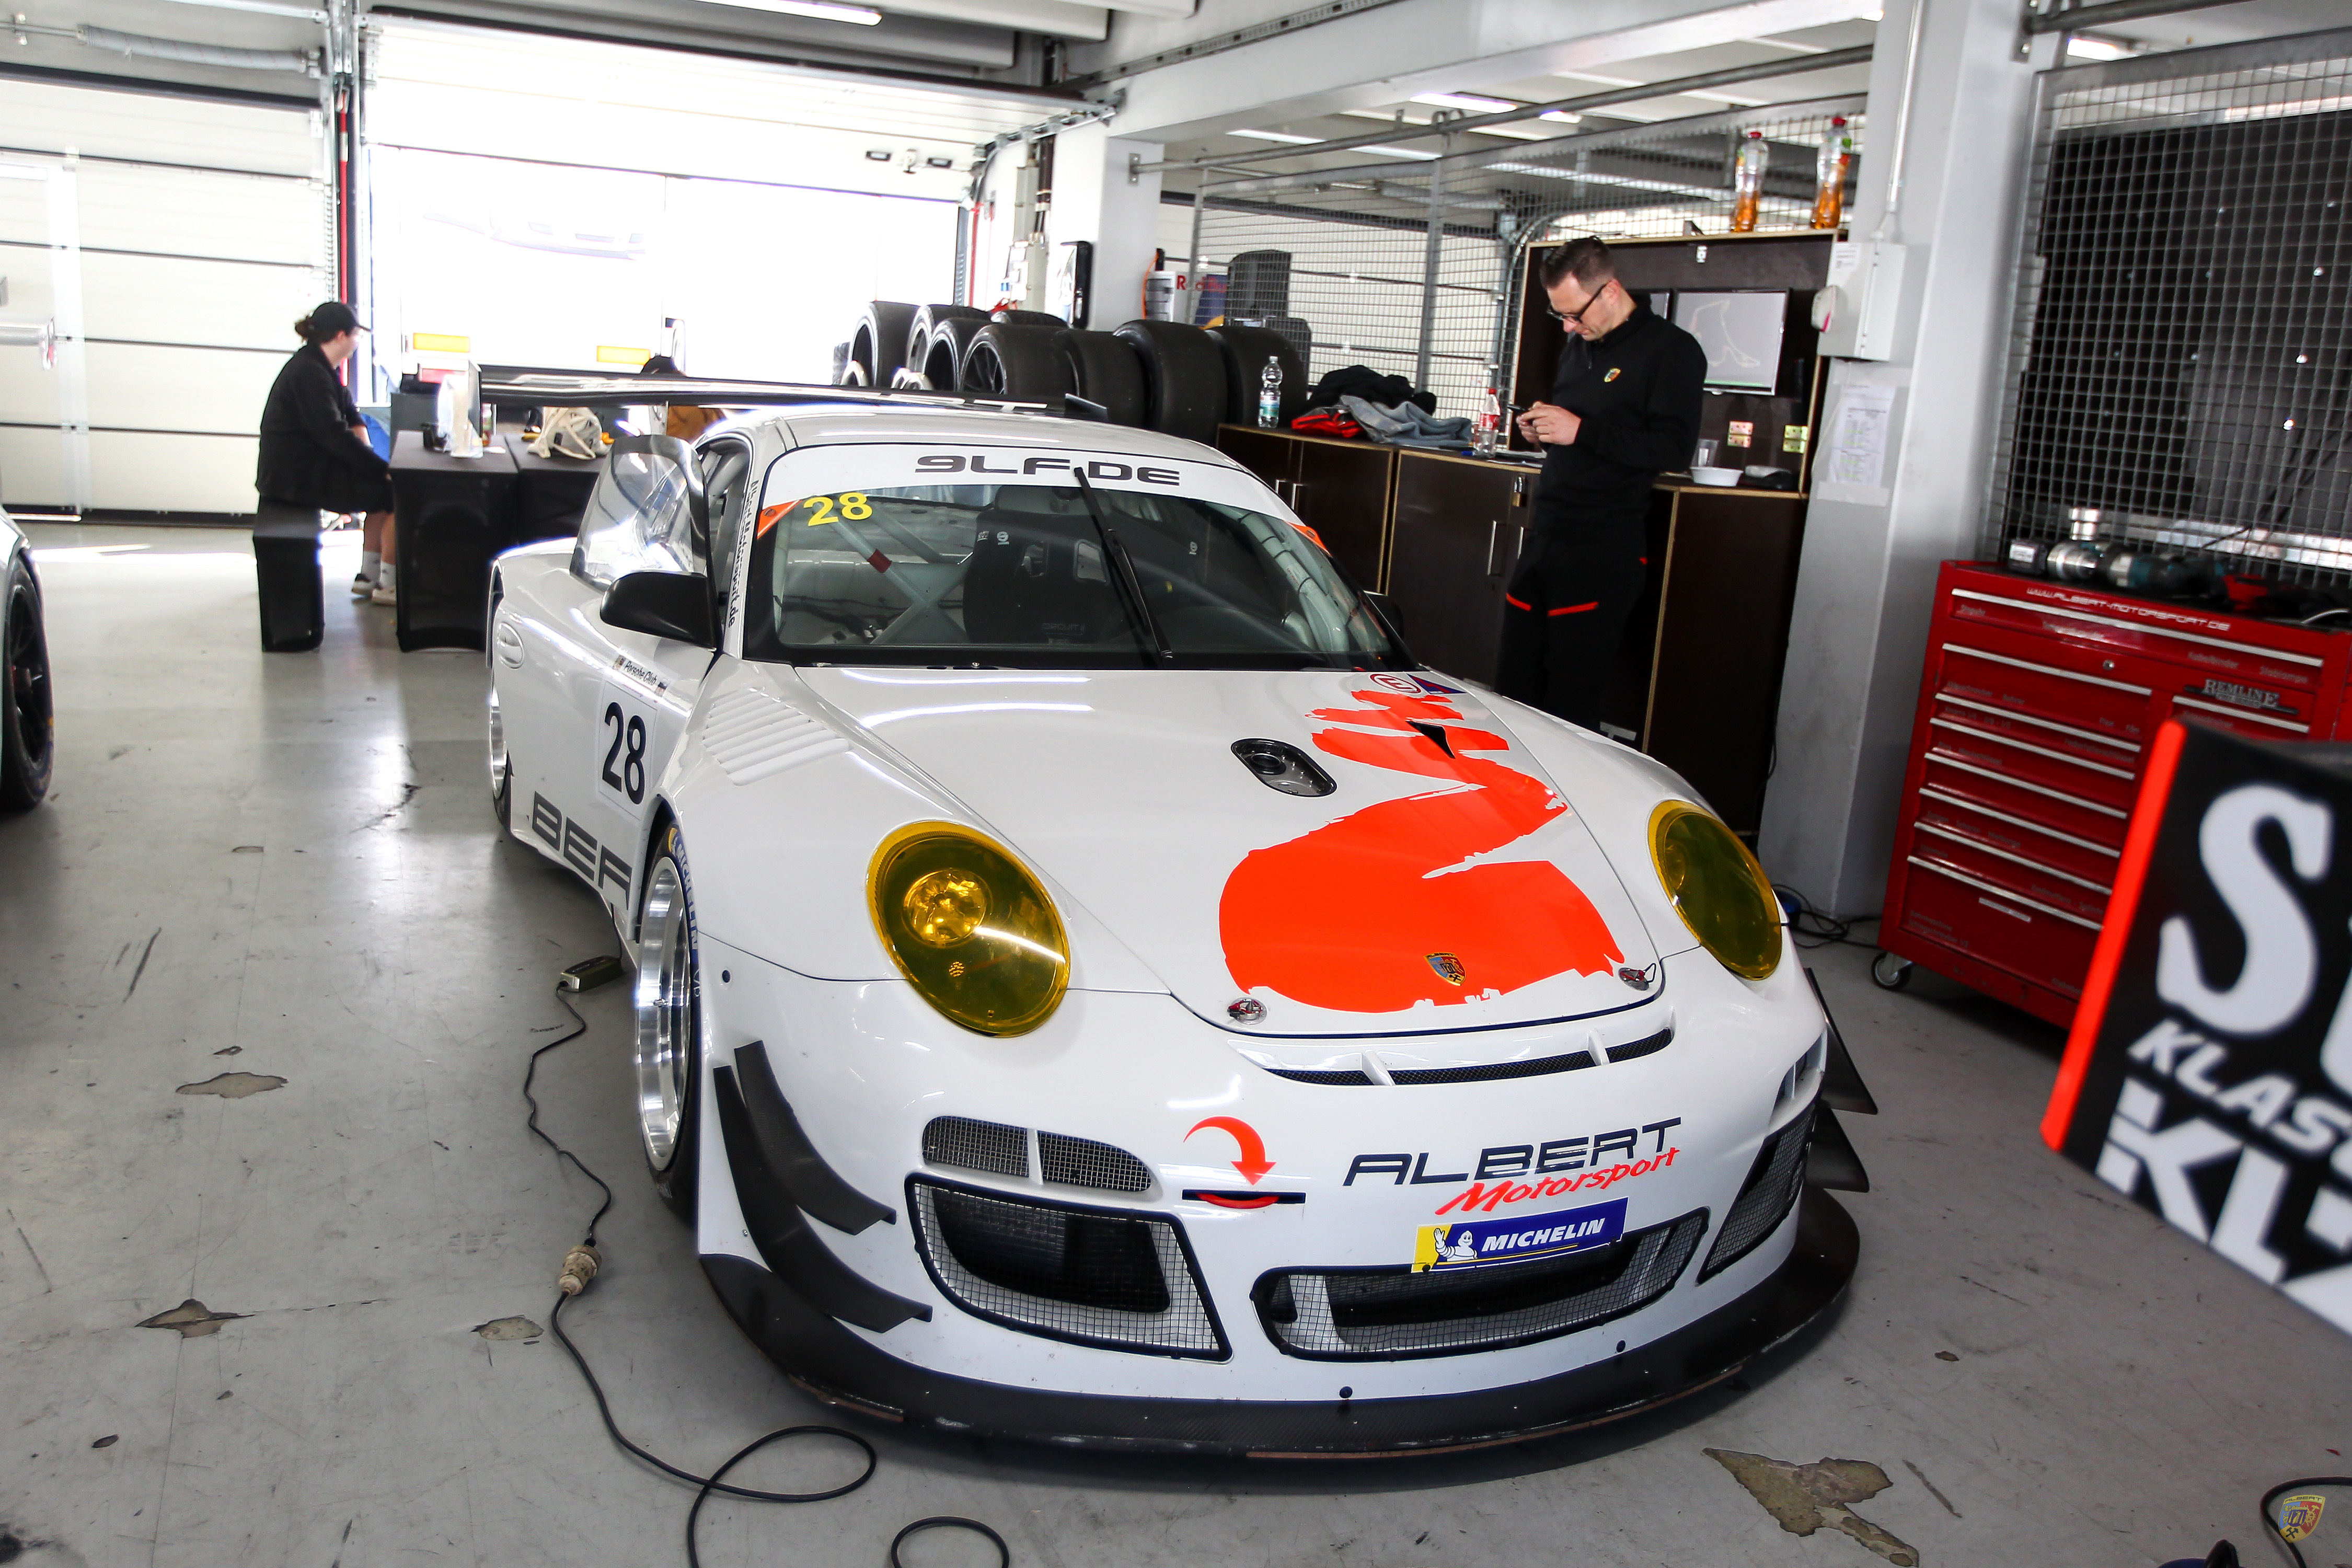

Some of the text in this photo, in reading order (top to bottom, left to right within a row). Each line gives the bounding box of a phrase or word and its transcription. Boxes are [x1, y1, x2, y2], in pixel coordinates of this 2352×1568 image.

[1177, 275, 1206, 292] Rd
[803, 492, 873, 527] 28
[624, 660, 658, 686] Porsche Club
[2204, 678, 2280, 707] REMLINE
[602, 702, 647, 805] 28
[675, 841, 698, 950] MICHELIN
[1343, 1117, 1681, 1186] ALBERT
[1435, 1147, 1680, 1215] Motorsport
[1480, 1217, 1605, 1252] MICHELIN
